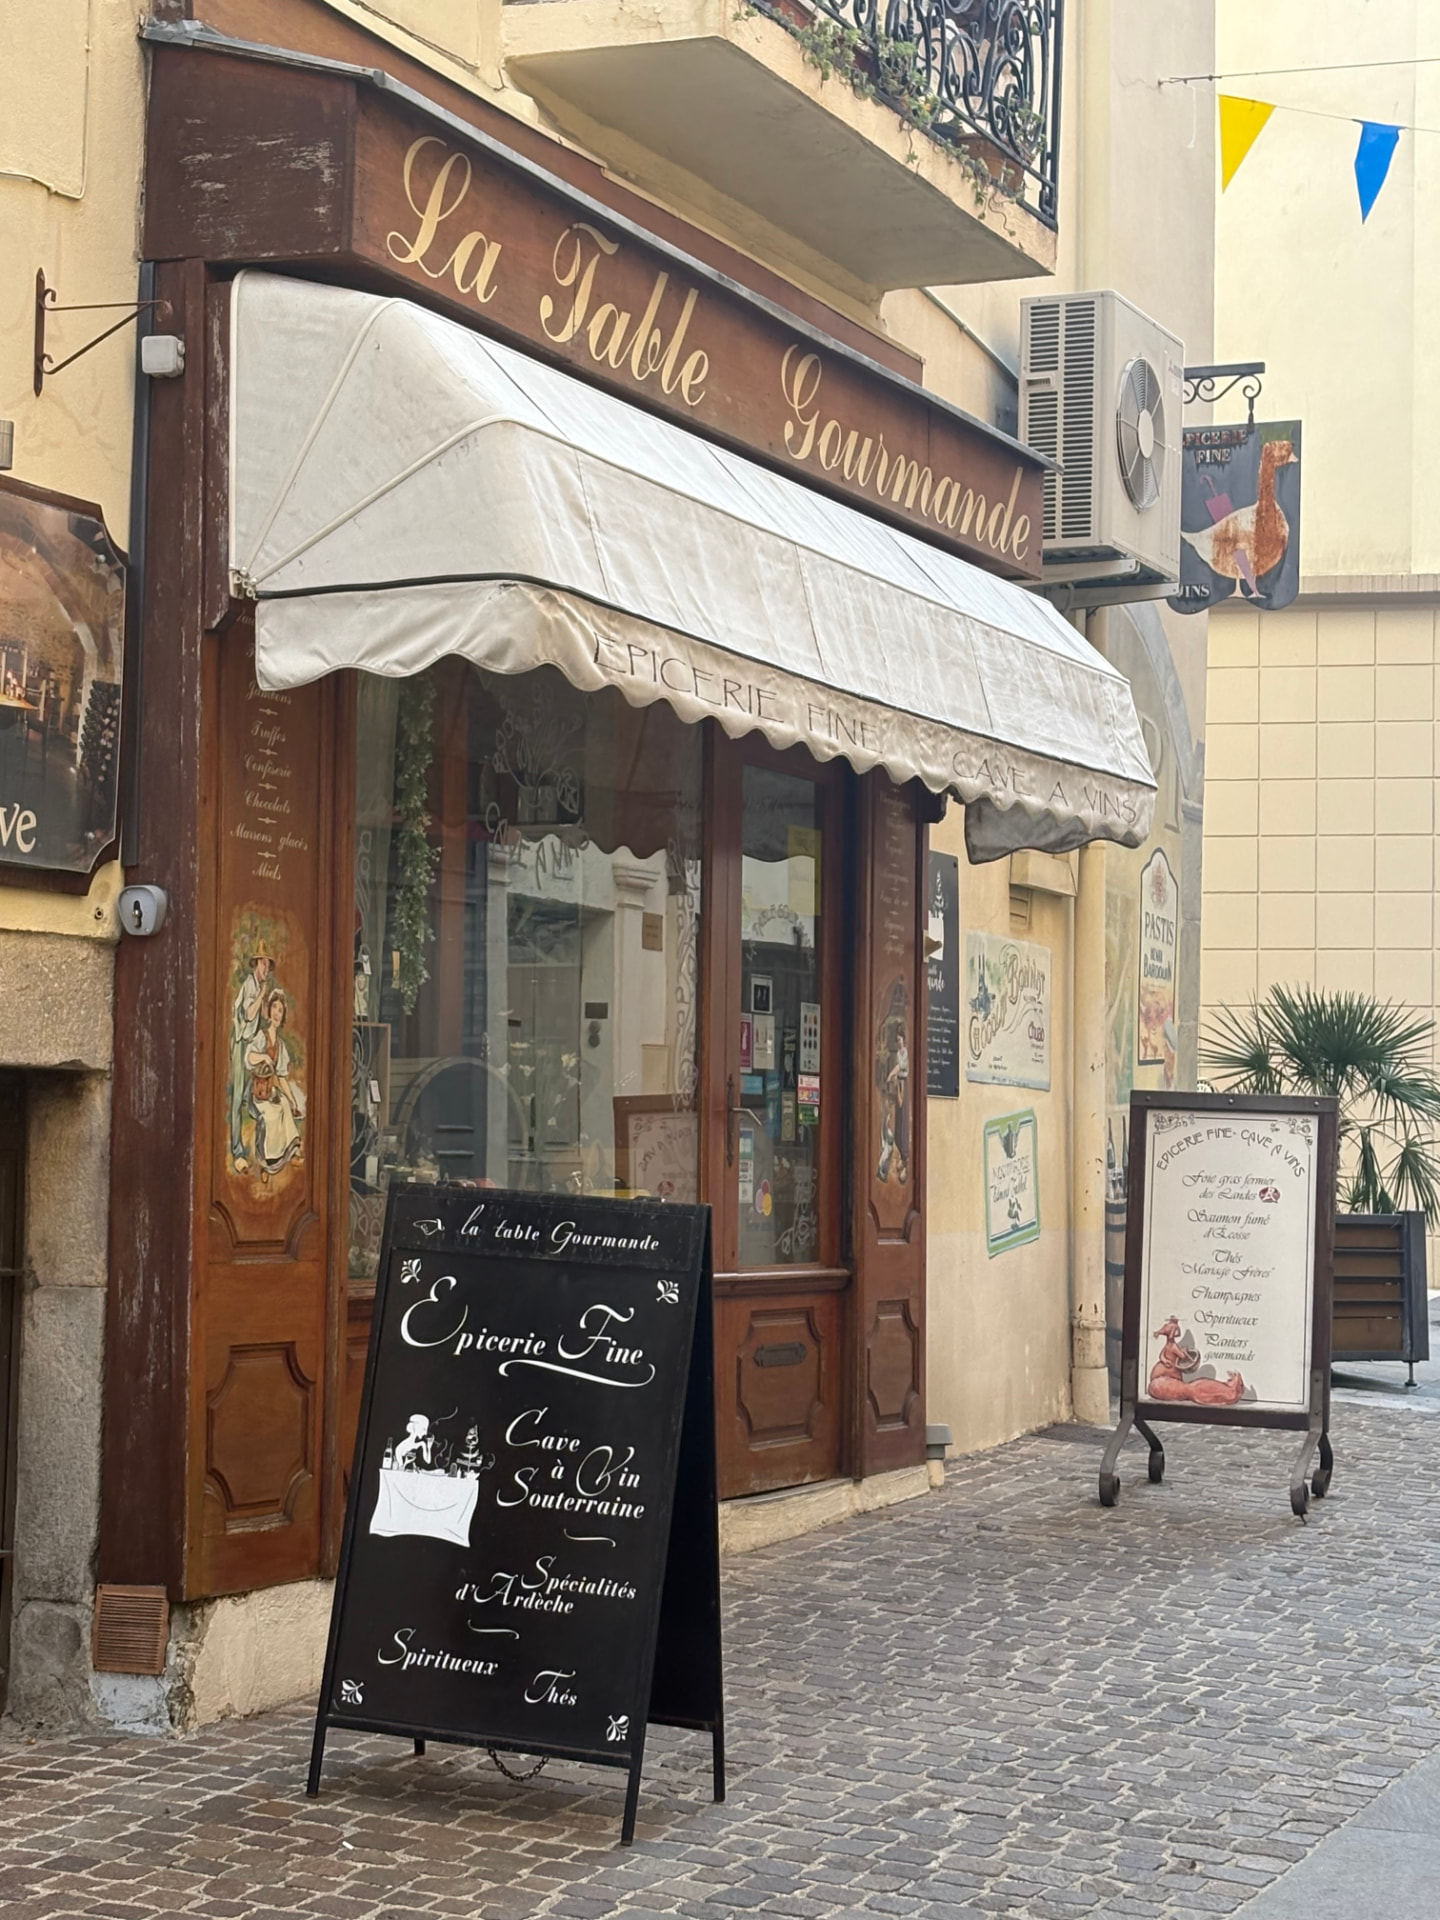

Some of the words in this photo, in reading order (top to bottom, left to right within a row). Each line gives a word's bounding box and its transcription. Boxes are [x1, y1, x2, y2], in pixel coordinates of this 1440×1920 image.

[386, 135, 501, 304] La
[540, 222, 710, 407] Table
[782, 343, 1031, 560] Gourmande
[1183, 429, 1248, 447] PICERIE
[1195, 448, 1231, 464] FINE
[251, 720, 286, 746] Truffes
[593, 632, 784, 723] EPICERIE
[807, 702, 884, 754] FINE
[951, 750, 1033, 797] CAVE
[1048, 781, 1068, 804] A
[1083, 787, 1138, 824] VINS
[244, 755, 292, 780] Confiserie
[244, 790, 290, 814] Chocolats
[230, 822, 272, 844] Marrons
[278, 831, 308, 851] glacés
[252, 862, 281, 881] Miels
[1145, 911, 1174, 946] PASTIS
[1156, 1132, 1204, 1171] EPICERIE
[1241, 1129, 1273, 1148] CAVE
[1271, 1144, 1283, 1157] A
[1284, 1150, 1306, 1178] VINS
[1182, 1169, 1216, 1187] Foie
[1218, 1174, 1240, 1189] gras
[1242, 1173, 1276, 1191] fermier
[1199, 1188, 1214, 1199] des
[1217, 1187, 1257, 1200] Landes
[460, 1204, 480, 1237] la
[495, 1219, 540, 1241] table
[551, 1221, 660, 1254] Gourmande
[1187, 1208, 1240, 1225] Saumon
[1240, 1209, 1271, 1228] fumé
[1212, 1249, 1243, 1264] Thés
[1191, 1285, 1263, 1306] Champagnes
[400, 1276, 547, 1356] Epicerie
[557, 1304, 644, 1366] Fine
[1194, 1310, 1259, 1328] Spiritueux
[1204, 1333, 1249, 1349] Paniers
[1203, 1349, 1255, 1363] gourmands
[505, 1407, 581, 1453] Cave
[551, 1459, 564, 1480] à
[575, 1446, 641, 1497] Vin
[496, 1468, 646, 1519] Souterraine
[521, 1556, 638, 1600] Spécialités
[455, 1572, 575, 1614] d'Ardèche
[377, 1628, 499, 1676] Spiritueux
[524, 1669, 578, 1706] Thés
